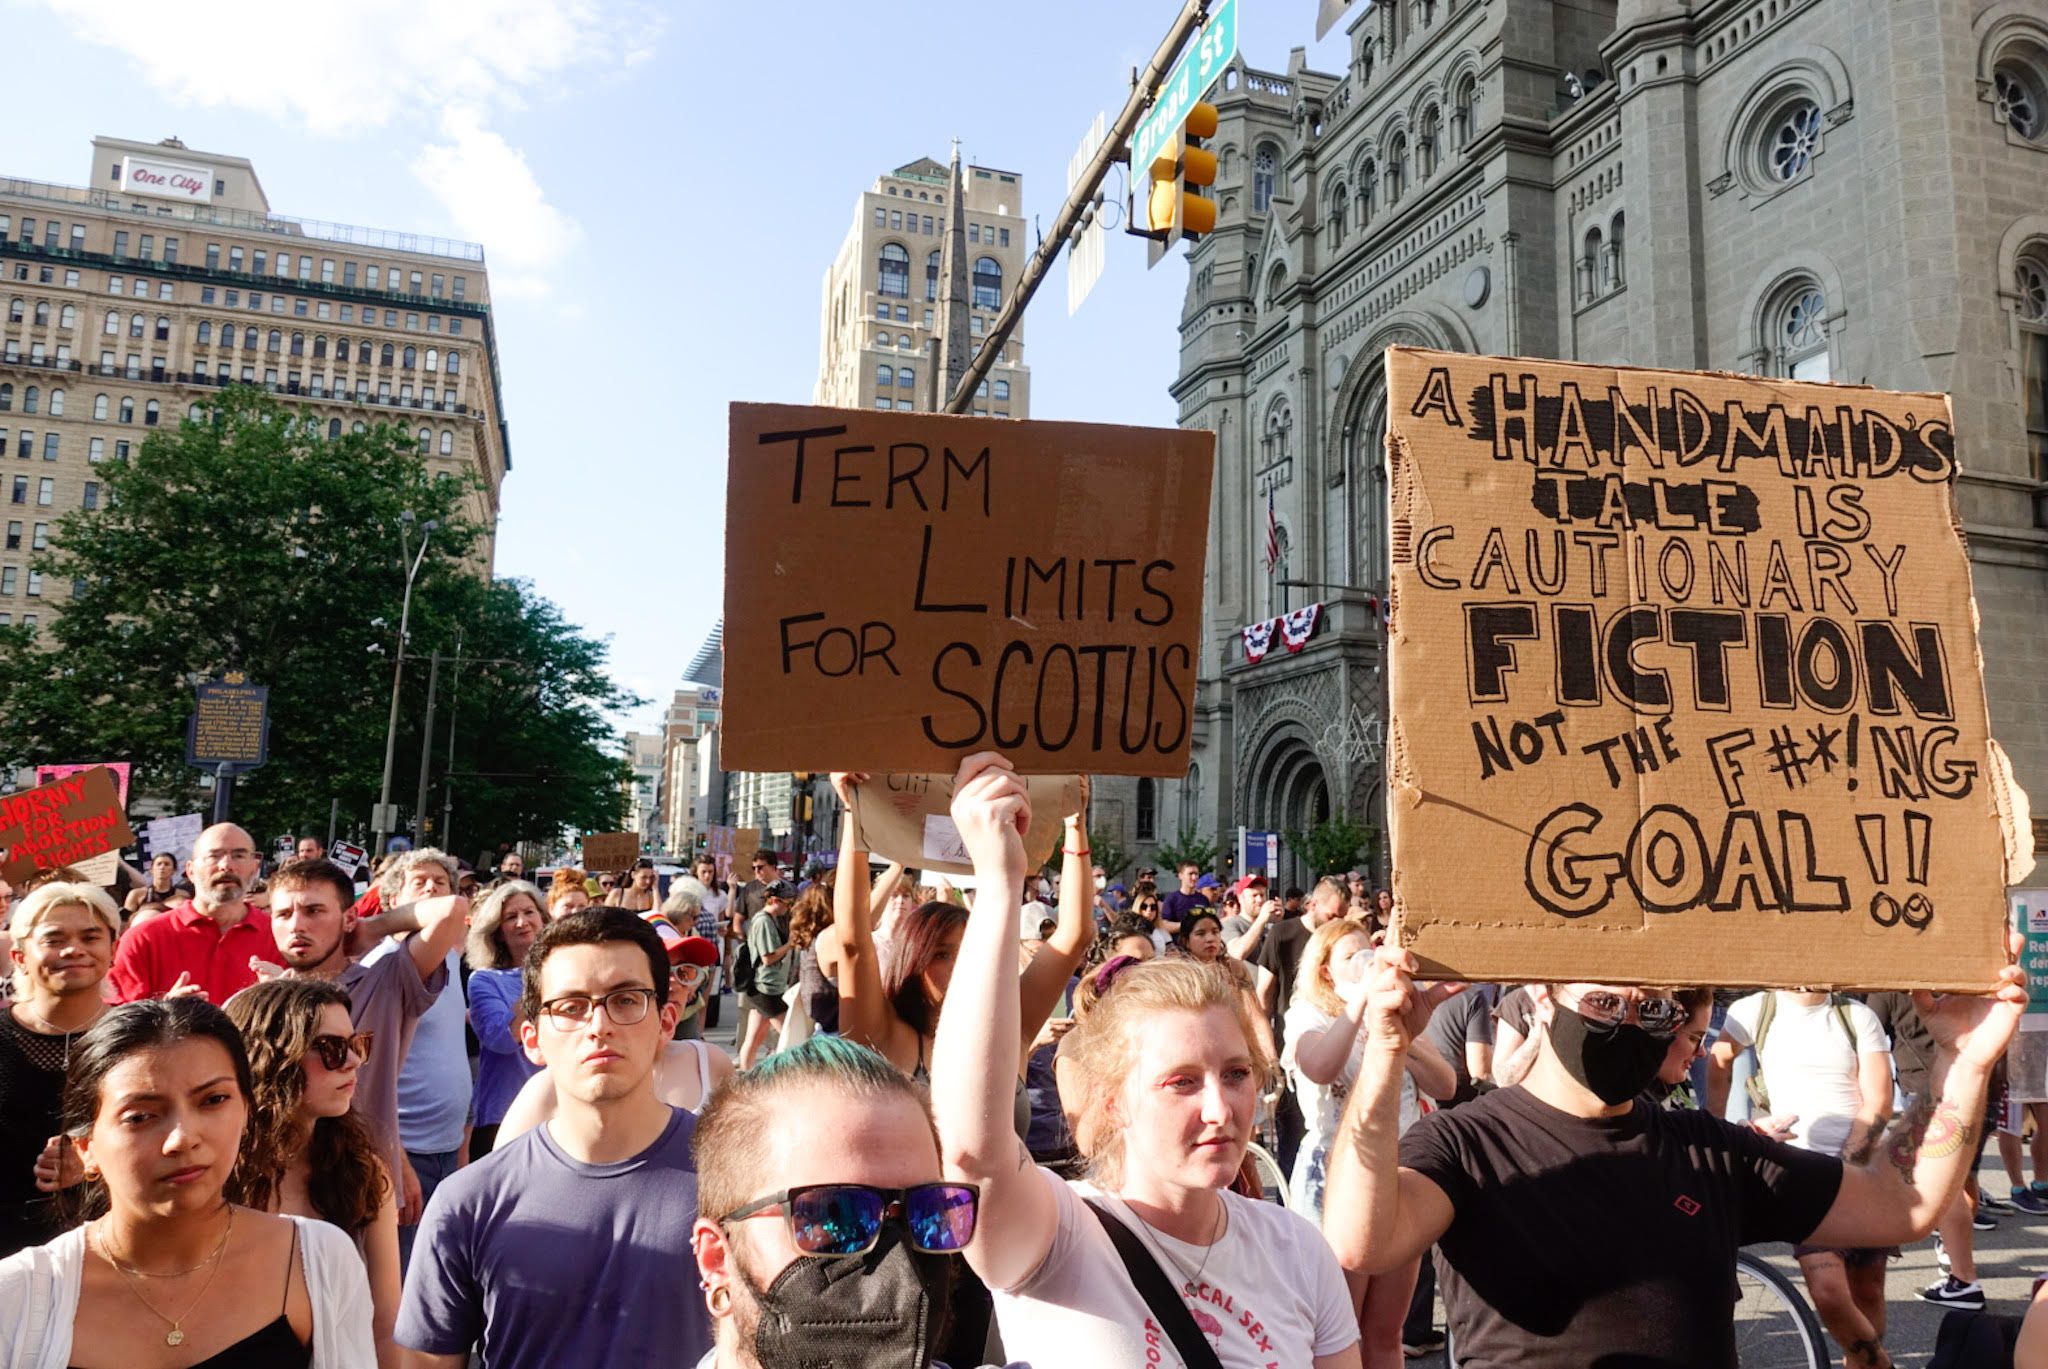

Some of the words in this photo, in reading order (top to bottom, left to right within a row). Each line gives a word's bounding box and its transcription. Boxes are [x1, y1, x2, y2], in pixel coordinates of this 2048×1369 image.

[1138, 64, 1190, 165] Broad
[1200, 20, 1225, 76] St
[133, 168, 166, 186] One
[169, 173, 204, 196] City
[1411, 367, 1464, 428] A
[1486, 372, 1955, 485] HANDMAID'S
[758, 425, 991, 517] TERM
[1534, 467, 1755, 537] TALE
[1795, 483, 1872, 543] IS
[914, 524, 1177, 627] LIMITS
[1416, 525, 1906, 617] CAUTIONARY
[779, 611, 901, 677] FOR
[1463, 601, 1956, 722] FICTION
[920, 639, 1191, 755] SCOTUS
[1472, 709, 1569, 780] NOT
[1582, 716, 1681, 788] THE
[0, 776, 86, 832] HORNY
[10, 806, 118, 863] ABORTION
[22, 812, 65, 842] FOR
[33, 831, 112, 869] RIGHTS
[1238, 1310, 1273, 1353] SEX
